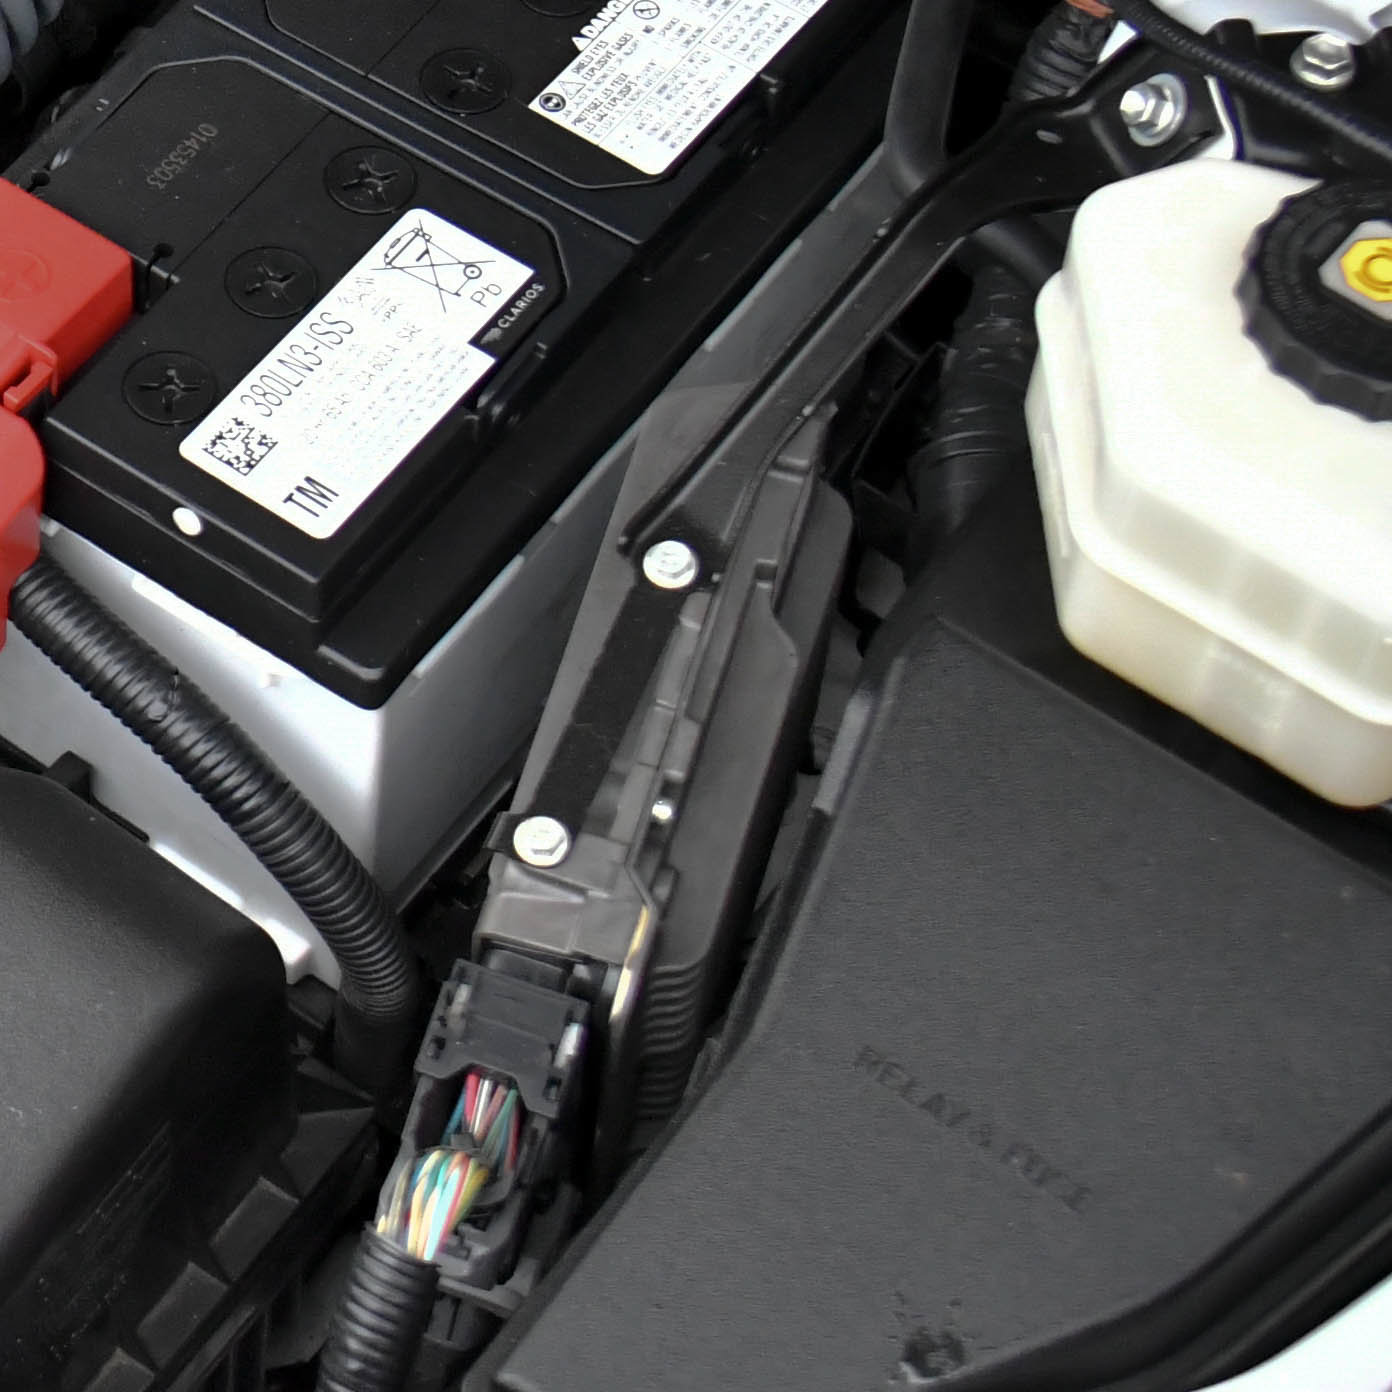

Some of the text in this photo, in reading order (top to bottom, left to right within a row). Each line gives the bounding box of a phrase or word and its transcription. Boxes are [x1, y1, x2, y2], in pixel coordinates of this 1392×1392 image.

[470, 283, 503, 307] Pb
[497, 282, 547, 329] CLARIOS
[240, 311, 355, 419] 380LN3-ISS
[283, 475, 340, 518] TM
